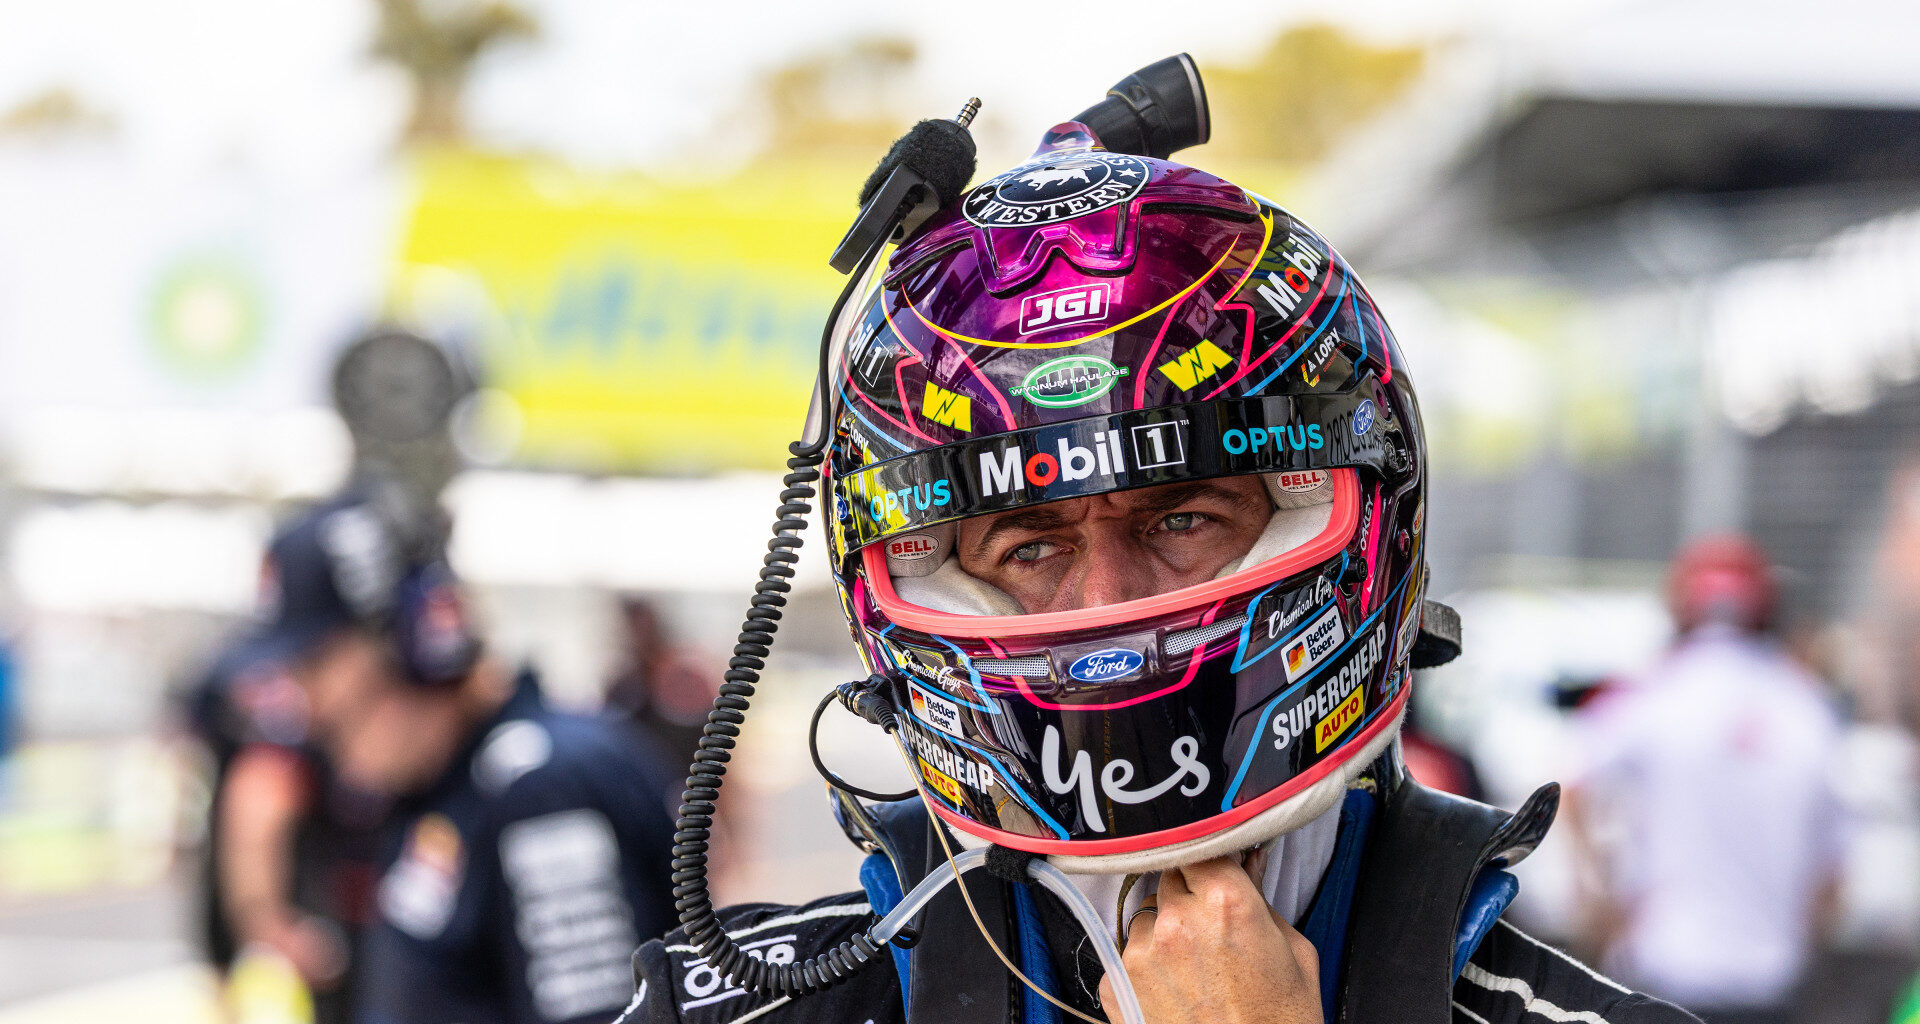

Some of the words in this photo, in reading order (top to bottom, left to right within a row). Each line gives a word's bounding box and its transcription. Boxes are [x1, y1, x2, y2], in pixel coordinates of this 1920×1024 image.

[977, 179, 1132, 223] WESTERN
[1256, 232, 1322, 319] Mobil
[1027, 290, 1101, 327] JGI
[1314, 326, 1341, 365] LORY
[865, 346, 882, 378] 1
[1011, 378, 1069, 396] WYNNUM
[1069, 368, 1128, 385] HAULAGE
[1222, 424, 1324, 455] OPTUS
[979, 429, 1125, 497] Mobil
[1146, 428, 1166, 463] 1
[1281, 471, 1321, 487] BELL
[870, 479, 951, 522] OPTUS
[891, 540, 931, 554] BELL
[1269, 588, 1314, 639] Chemical
[1306, 615, 1337, 648] Better
[1309, 635, 1335, 662] Beer.
[1085, 653, 1129, 677] Ford
[1272, 622, 1386, 750] SUPERCHEAP
[926, 696, 956, 720] Better
[929, 709, 953, 731] Beer.
[1321, 697, 1359, 743] AUTO
[924, 765, 956, 797] AUTO
